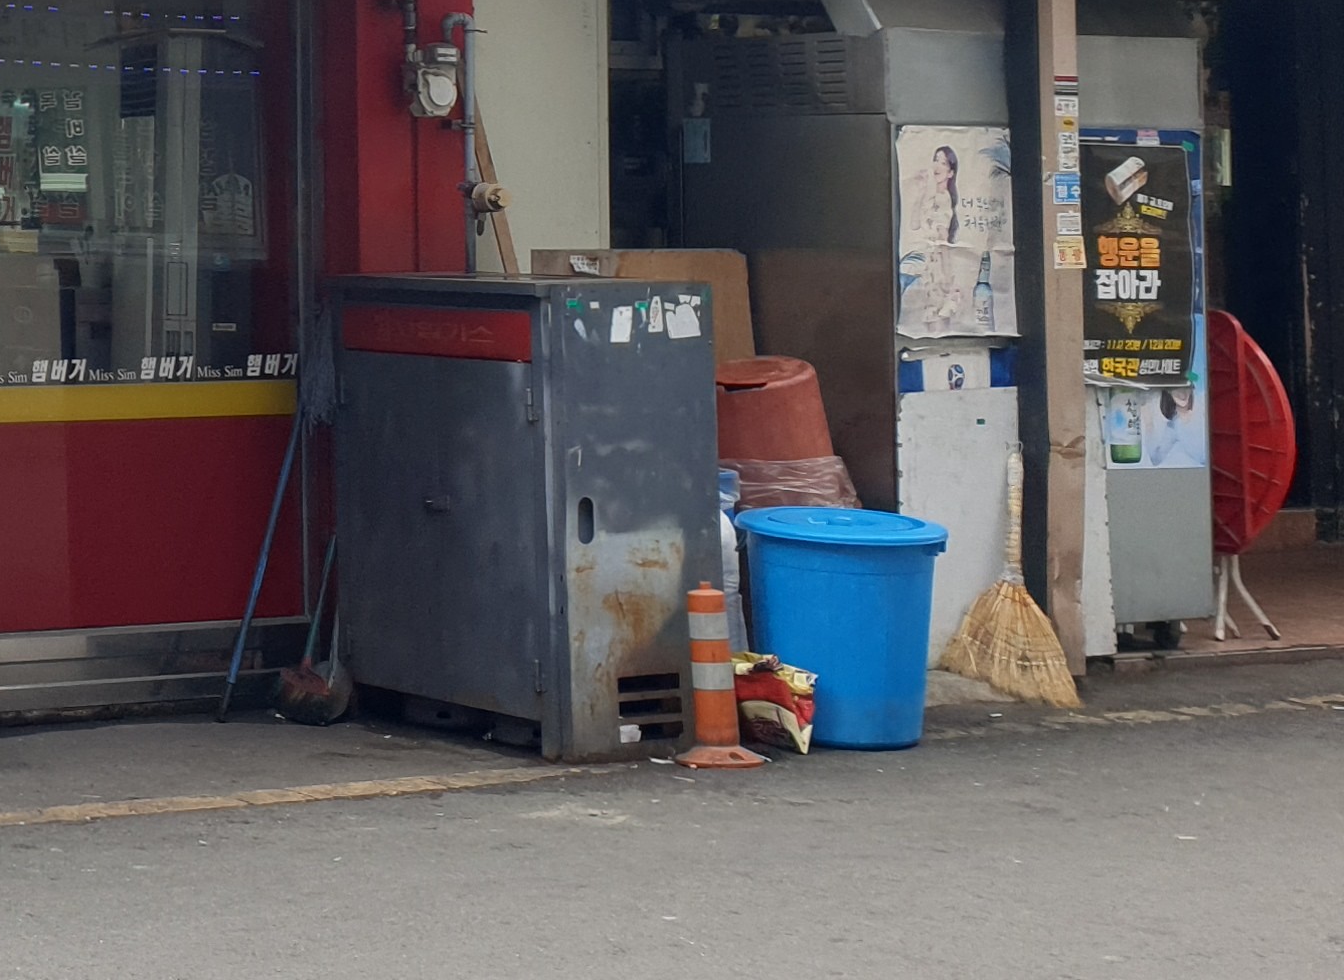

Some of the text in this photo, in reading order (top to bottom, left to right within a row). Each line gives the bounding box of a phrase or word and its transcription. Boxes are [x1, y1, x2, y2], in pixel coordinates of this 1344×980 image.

[1097, 235, 1161, 268] 행운을
[1095, 269, 1161, 300] 잡아라
[7, 370, 28, 383] Sim
[31, 358, 87, 382] 햄버거
[88, 355, 194, 382] Miss Sim 햄버거
[197, 352, 298, 378] Miss Sim 햄버거
